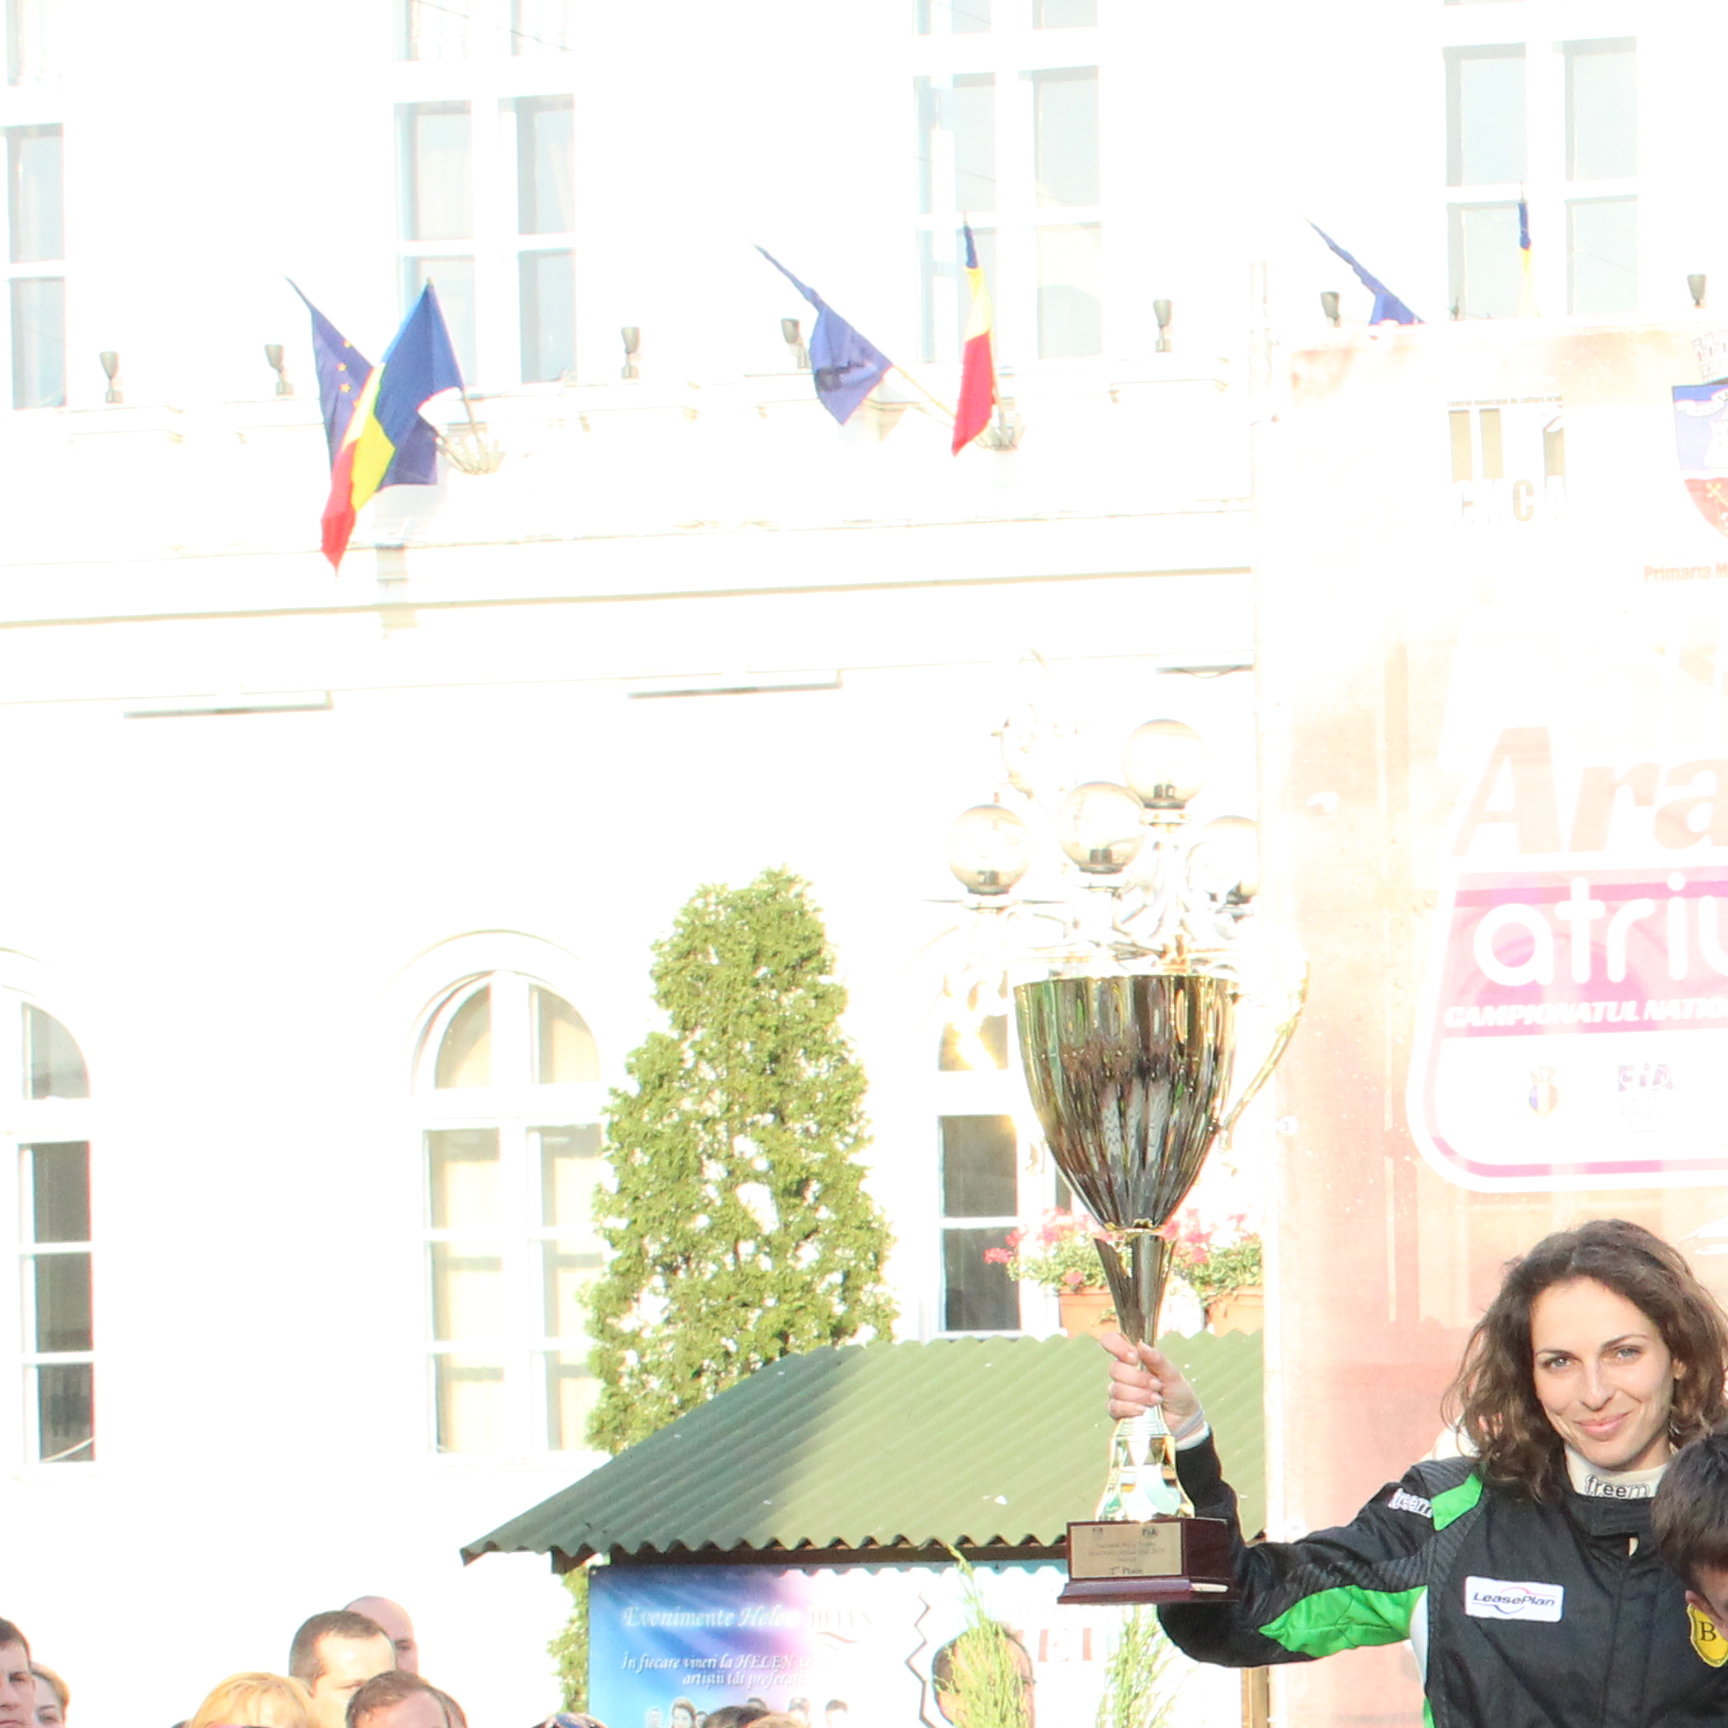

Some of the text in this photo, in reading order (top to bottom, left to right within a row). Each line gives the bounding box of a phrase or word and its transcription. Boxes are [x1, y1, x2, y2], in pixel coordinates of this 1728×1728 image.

[1644, 564, 1711, 582] Primaria
[1443, 999, 1642, 1029] CAMPIONATUL
[1583, 1474, 1650, 1499] freem
[1473, 1591, 1556, 1608] LeasePlan
[622, 1604, 799, 1627] Evenimente Helen
[735, 1653, 794, 1670] HELEN
